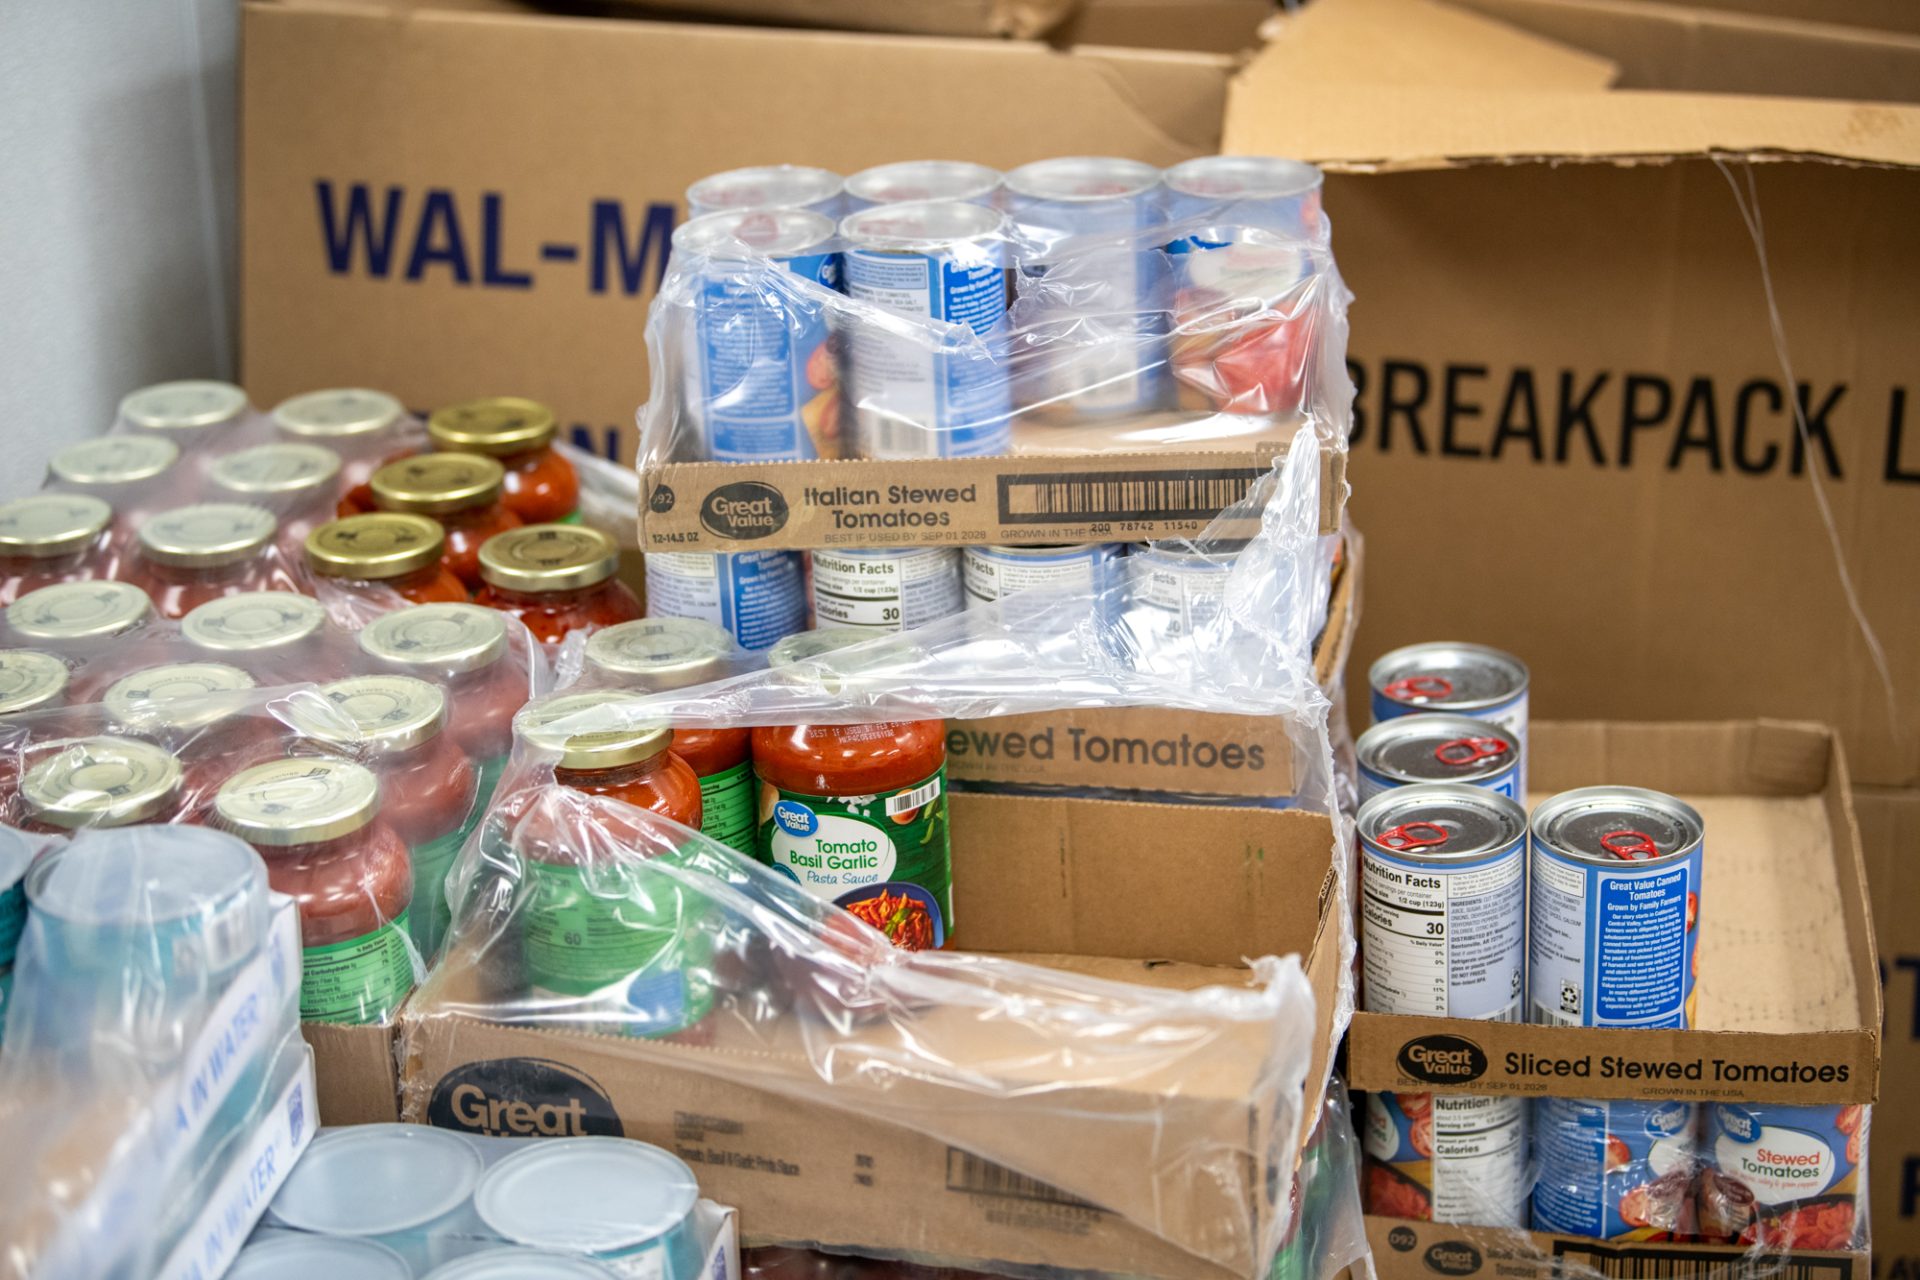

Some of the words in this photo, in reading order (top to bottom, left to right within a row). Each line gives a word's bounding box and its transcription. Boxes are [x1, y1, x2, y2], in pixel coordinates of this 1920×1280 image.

[314, 179, 678, 296] WAL-M
[652, 493, 673, 504] 92
[804, 487, 884, 507] Italian
[887, 484, 976, 504] Stewed
[711, 497, 772, 516] Great
[727, 515, 774, 528] Value
[832, 509, 950, 529] Tomatoes
[1119, 522, 1153, 531] 78742
[1164, 521, 1197, 531] 11540
[652, 533, 685, 544] 12-14.5
[686, 531, 699, 542] OZ
[824, 533, 852, 543] BEST
[854, 533, 864, 543] IF
[868, 532, 899, 543] USED
[902, 532, 916, 542] BY
[921, 531, 943, 541] SEP
[946, 531, 958, 541] 01
[960, 530, 986, 541] 2028
[1001, 529, 1046, 539] GROWN
[1049, 529, 1059, 538] IN
[1062, 528, 1086, 538] THE
[813, 552, 856, 574] Nutrition
[860, 563, 894, 575] Facts
[970, 557, 995, 577] Facts
[1152, 574, 1177, 586] acts
[883, 608, 900, 621] 30
[947, 727, 1054, 760] ewed
[1067, 727, 1265, 771] Tomatoes
[777, 806, 809, 824] Great
[784, 820, 810, 832] Value
[816, 839, 877, 854] Tomato
[790, 850, 823, 868] Basil
[827, 855, 878, 870] Garlic
[807, 870, 837, 884] Pasta
[842, 872, 878, 884] Sauce
[1363, 855, 1402, 885] Nutrition
[1405, 874, 1441, 889] Facts
[1610, 881, 1633, 891] Great
[1634, 880, 1656, 891] Value
[1629, 889, 1666, 901] Tomatoes
[1426, 923, 1444, 935] 30
[1408, 1044, 1472, 1065] Great
[1424, 1061, 1472, 1075] Value
[1505, 1052, 1591, 1078] Sliced
[1600, 1055, 1702, 1081] Stewed
[1712, 1059, 1849, 1083] Tomatoes
[1470, 1081, 1483, 1089] BY
[1486, 1081, 1507, 1090] SEP
[1642, 1087, 1683, 1096] GROWN
[1686, 1088, 1696, 1096] IN
[1700, 1089, 1719, 1097] THE
[1721, 1090, 1744, 1098] USA
[451, 1083, 588, 1137] Great
[1436, 1096, 1490, 1111] Nutrition
[1437, 1145, 1480, 1155] Calories
[1757, 1149, 1820, 1166] Stewed
[1741, 1157, 1819, 1178] Tomatoes
[1389, 1233, 1415, 1246] D92
[1431, 1249, 1473, 1264] Great
